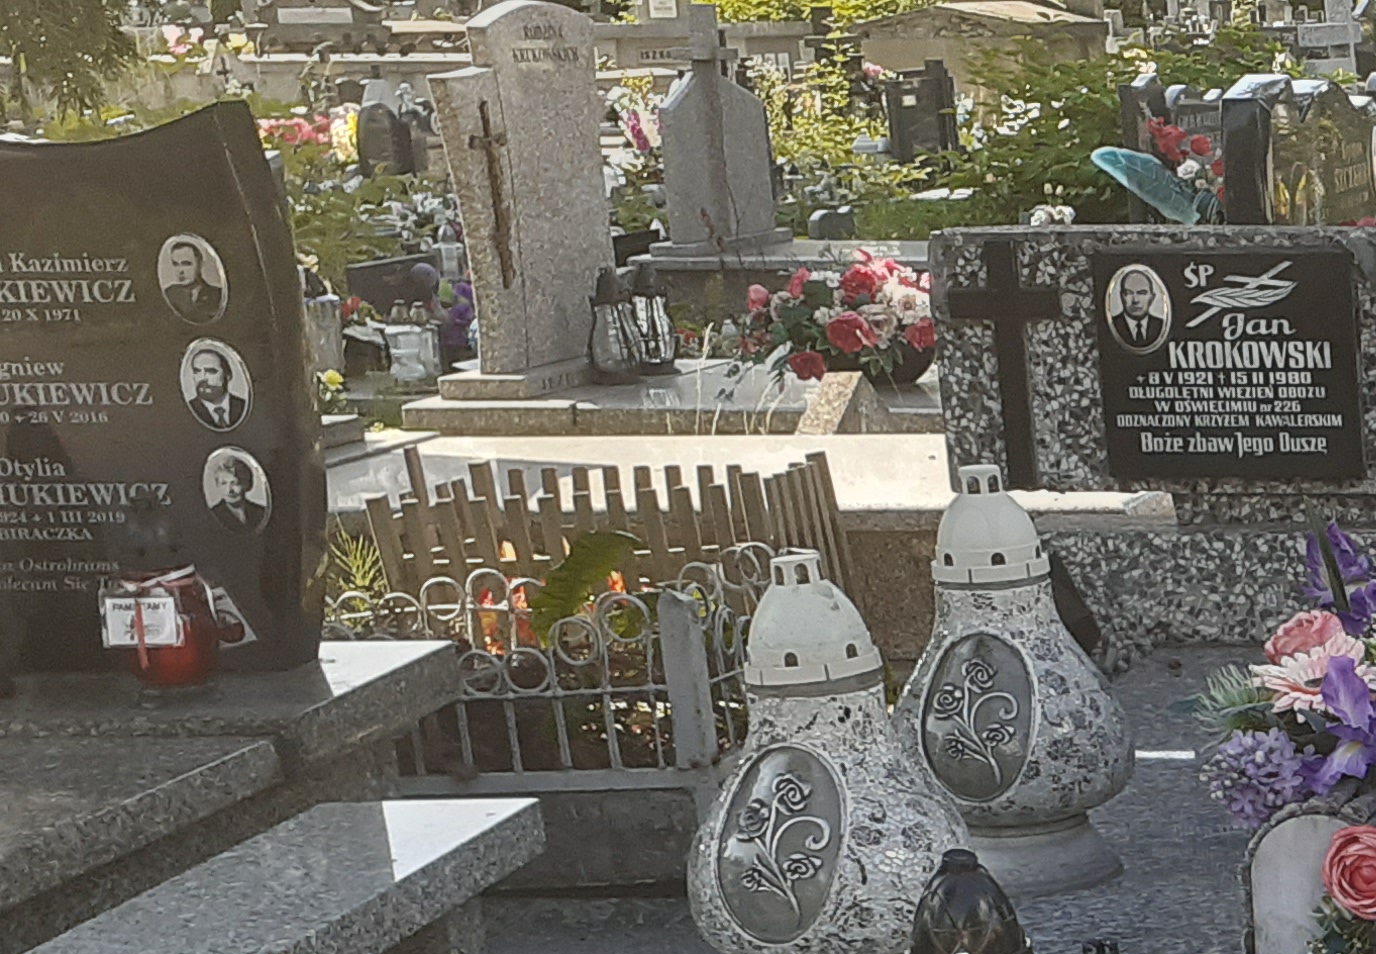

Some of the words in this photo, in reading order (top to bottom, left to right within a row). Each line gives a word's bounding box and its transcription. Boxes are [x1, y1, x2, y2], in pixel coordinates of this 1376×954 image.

[8, 252, 129, 273] Kazimierz
[26, 308, 38, 321] X
[44, 309, 82, 323] 1971
[1222, 312, 1297, 341] Jan
[1168, 340, 1333, 369] KROKOWSKI
[1149, 372, 1160, 384] 8
[1162, 372, 1174, 385] V
[1178, 372, 1214, 385] 1921
[1230, 372, 1248, 385] 15
[1269, 371, 1312, 385] 1980
[1278, 386, 1327, 398] OBOZU
[1154, 401, 1171, 412] W
[1260, 403, 1273, 412] nr
[1274, 400, 1301, 412] 226
[52, 410, 64, 423] V
[1117, 414, 1191, 427] ODZNACZONY
[1255, 414, 1343, 427] KAWALERSKIM
[1140, 432, 1184, 453] Boże
[1187, 433, 1233, 453] zbaw
[1234, 432, 1275, 458] Jego
